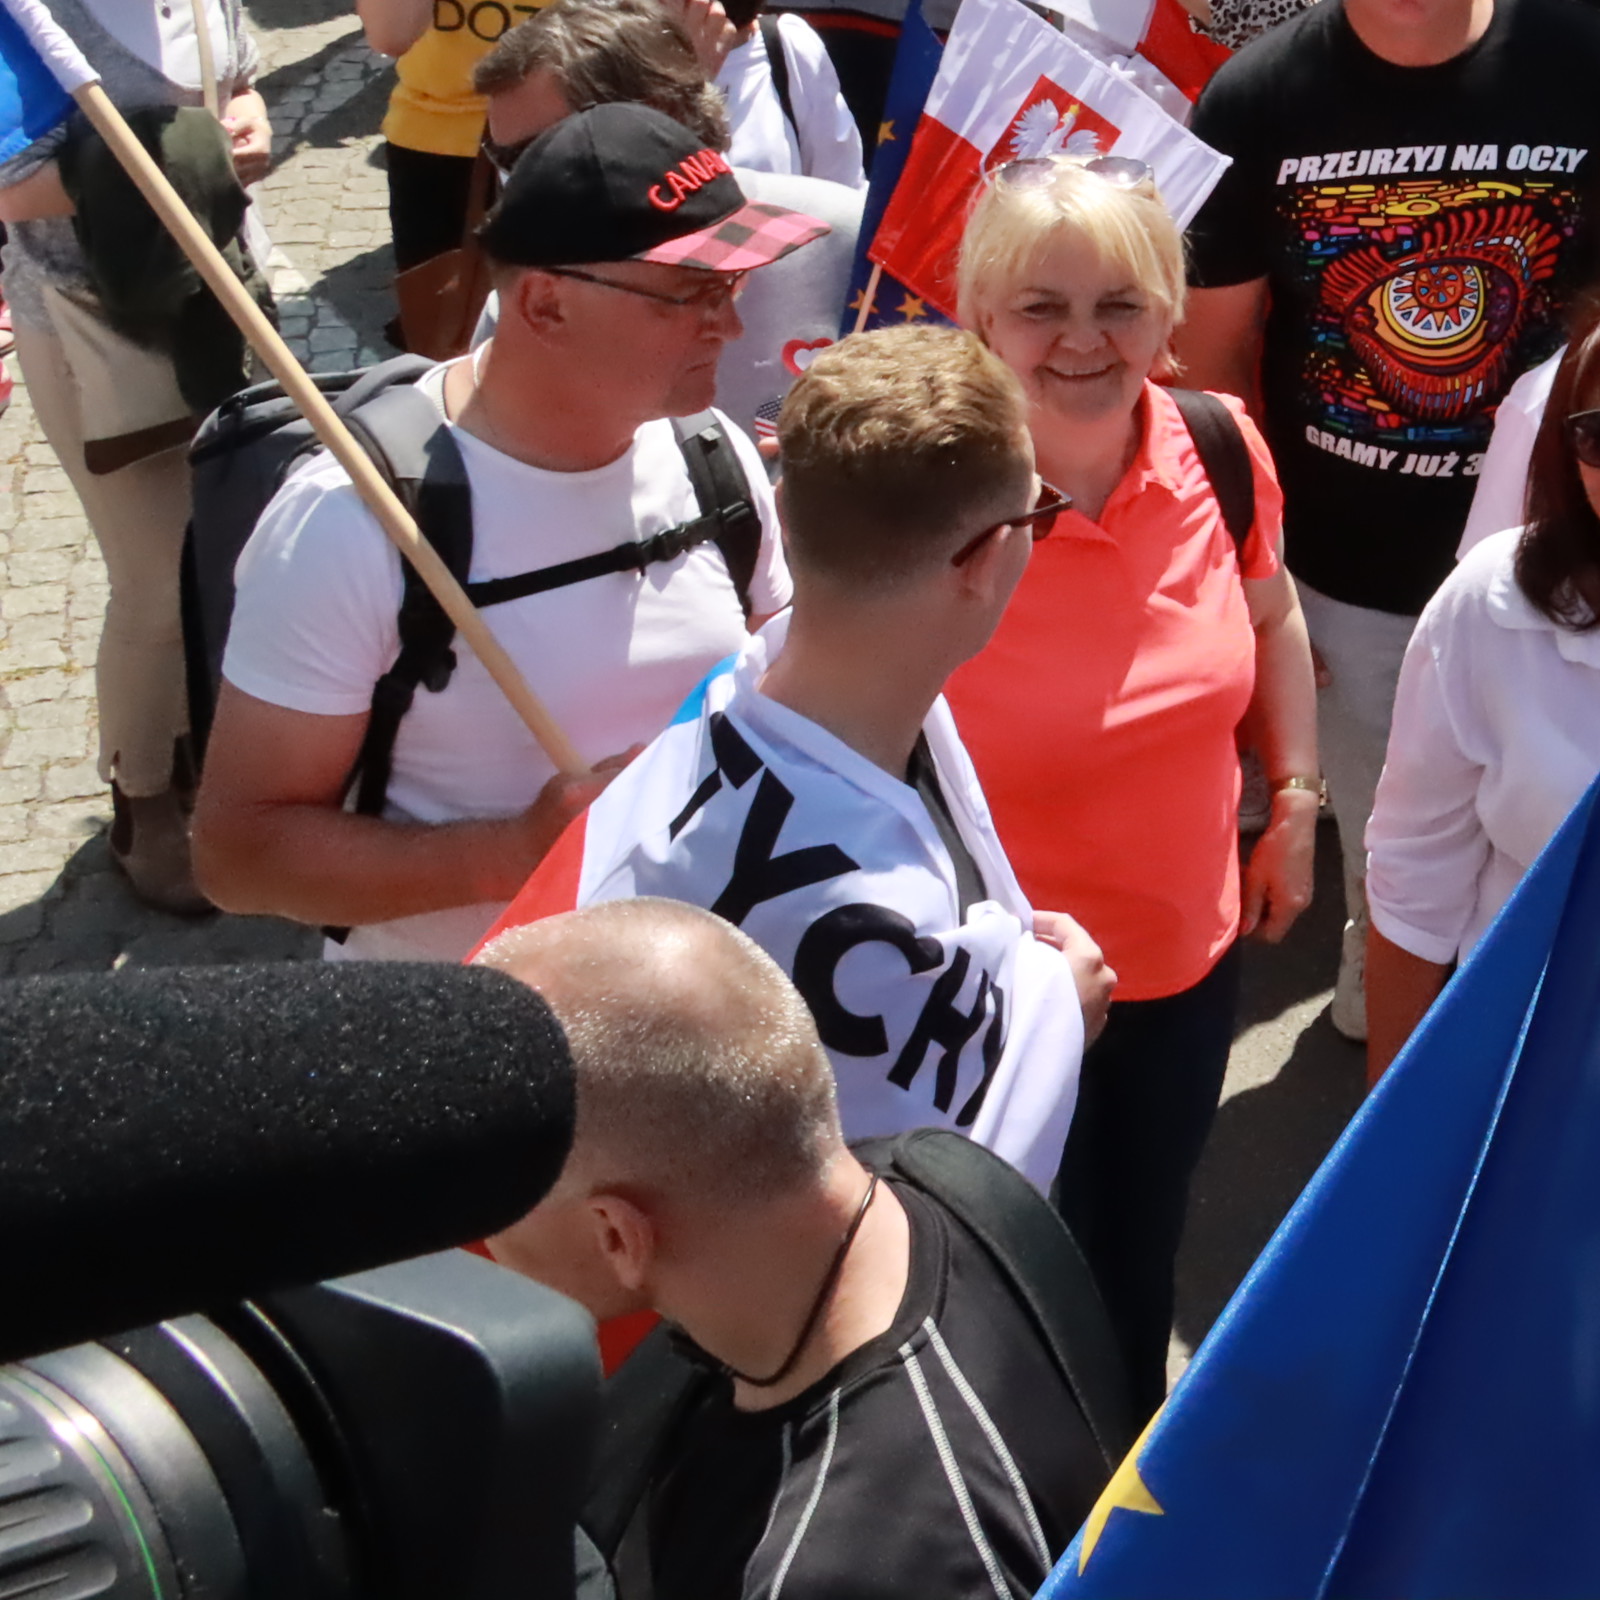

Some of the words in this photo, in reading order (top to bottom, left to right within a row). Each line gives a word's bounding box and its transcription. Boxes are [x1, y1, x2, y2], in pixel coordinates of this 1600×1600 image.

[648, 147, 734, 212] CANA
[1276, 145, 1447, 185] PRZEJRZYJ
[1451, 145, 1499, 172] NA
[1506, 144, 1589, 174] OCZY
[1306, 425, 1398, 470] GRAMY
[1399, 451, 1460, 478] JUŻ
